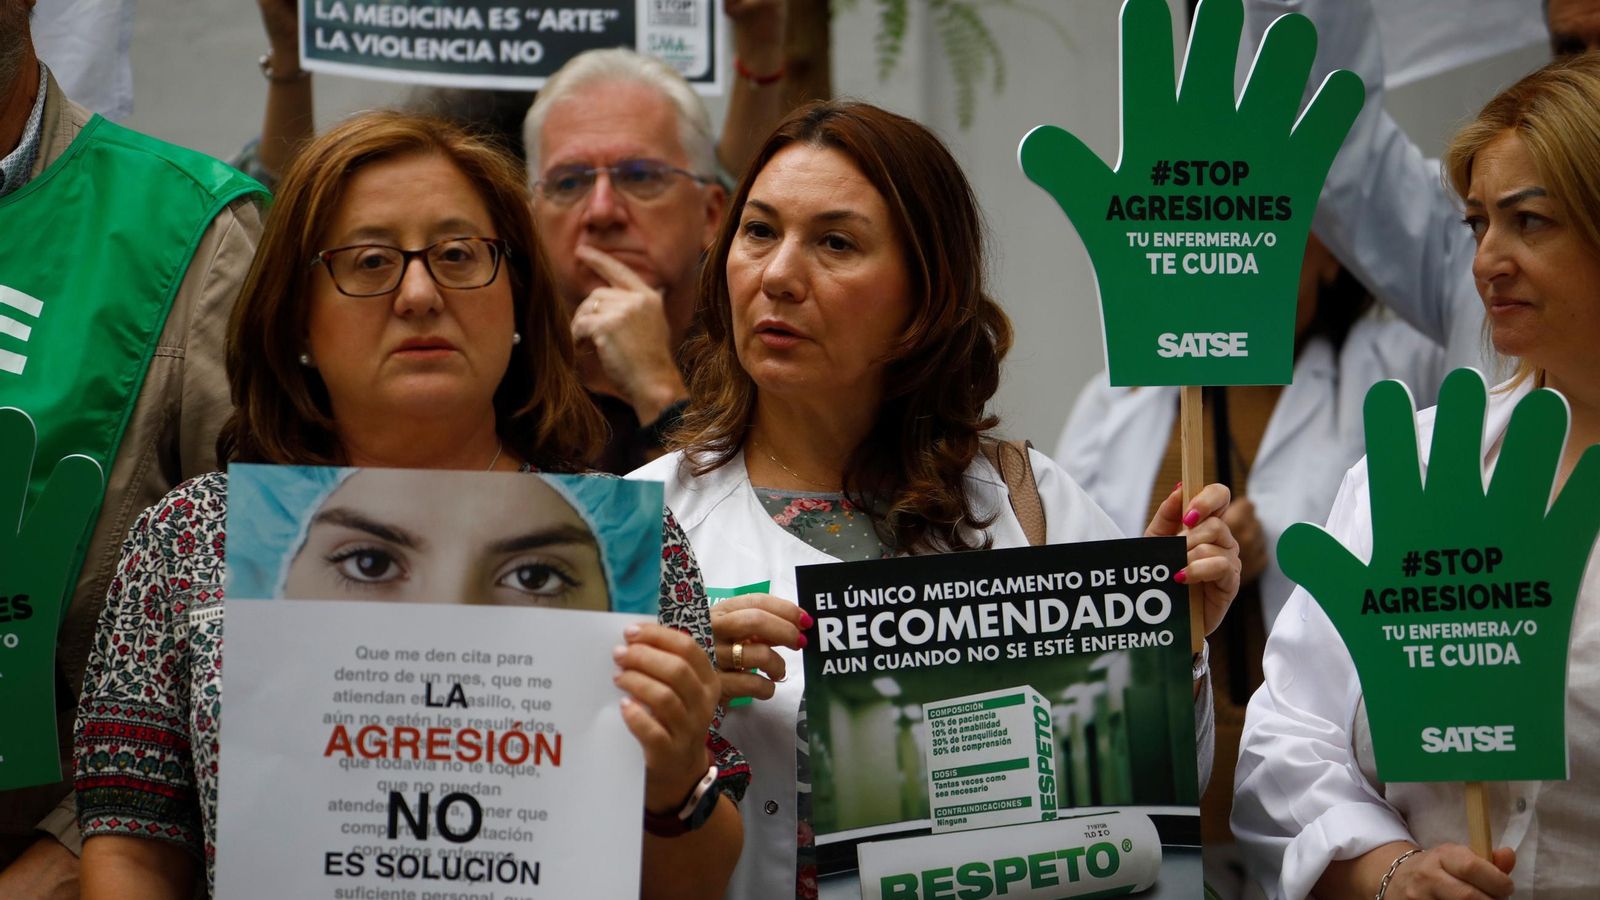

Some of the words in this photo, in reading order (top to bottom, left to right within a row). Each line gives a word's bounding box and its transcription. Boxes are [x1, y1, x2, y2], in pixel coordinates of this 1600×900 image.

[314, 0, 350, 23] LA
[353, 3, 484, 30] MEDICINA
[488, 7, 522, 31] ES
[524, 8, 620, 33] “ARTE”
[315, 27, 350, 52] LA
[351, 32, 496, 63] VIOLENCIA
[499, 40, 545, 64] NO
[1151, 160, 1250, 186] #STOP
[1106, 195, 1292, 221] AGRESIONES
[1126, 232, 1149, 247] TU
[1153, 232, 1277, 247] ENFERMERA/O
[1146, 252, 1177, 275] TE
[1182, 252, 1260, 275] CUIDA
[1157, 332, 1249, 358] SATSE
[1402, 547, 1503, 577] #STOP
[815, 592, 838, 611] EL
[844, 585, 916, 609] ÚNICO
[923, 571, 1083, 601] MEDICAMENTO
[1090, 568, 1117, 588] DE
[1123, 564, 1170, 585] USO
[1361, 581, 1553, 615] AGRESIONES
[817, 588, 1172, 652] RECOMENDADO
[1382, 625, 1406, 640] TU
[1409, 620, 1538, 640] ENFERMERA/O
[355, 645, 390, 661] Que
[395, 650, 420, 661] me
[425, 648, 456, 663] den
[461, 649, 492, 664] cita
[497, 653, 533, 667] para
[821, 656, 868, 675] AUN
[873, 648, 961, 671] CUANDO
[967, 644, 1000, 663] NO
[1006, 642, 1028, 659] SE
[1034, 632, 1075, 657] ESTÉ
[1081, 630, 1174, 653] ENFERMO
[1403, 644, 1435, 668] TE
[1440, 642, 1521, 667] CUIDA
[334, 667, 389, 682] dentro
[394, 669, 415, 683] de
[420, 673, 441, 684] un
[491, 675, 522, 690] que
[527, 677, 552, 689] me
[332, 688, 406, 704] atiendan
[521, 699, 552, 713] que
[424, 682, 468, 709] LA
[323, 710, 354, 725] aún
[360, 714, 381, 726] no
[386, 711, 431, 727] estén
[438, 714, 461, 729] los
[930, 703, 984, 718] COMPOSICIÓN
[931, 720, 946, 729] 10%
[947, 718, 957, 726] de
[959, 712, 996, 725] paciencia
[932, 729, 946, 738] 10%
[948, 726, 958, 735] de
[959, 719, 1001, 733] amabilidad
[950, 735, 960, 744] de
[961, 727, 1008, 742] tranquilidad
[1421, 725, 1516, 753] SATSE
[323, 721, 562, 767] AGRESIÓN
[950, 744, 960, 753] de
[962, 738, 1012, 751] comprensión
[339, 758, 371, 772] que
[442, 761, 463, 773] no
[469, 761, 483, 774] te
[934, 769, 958, 779] DOSIS
[377, 780, 408, 794] que
[413, 782, 435, 794] no
[440, 783, 502, 797] puedan
[934, 780, 960, 790] Tantas
[961, 776, 984, 786] veces
[985, 774, 1007, 783] como
[935, 789, 949, 798] sea
[950, 785, 989, 796] necesario
[328, 799, 392, 813] atende
[517, 808, 549, 823] que
[387, 791, 482, 843] NO
[936, 799, 1023, 816] CONTRAINDICACIONES
[937, 816, 968, 827] Ninguna
[325, 852, 364, 877] ES
[375, 852, 540, 885] SOLUCIÓN
